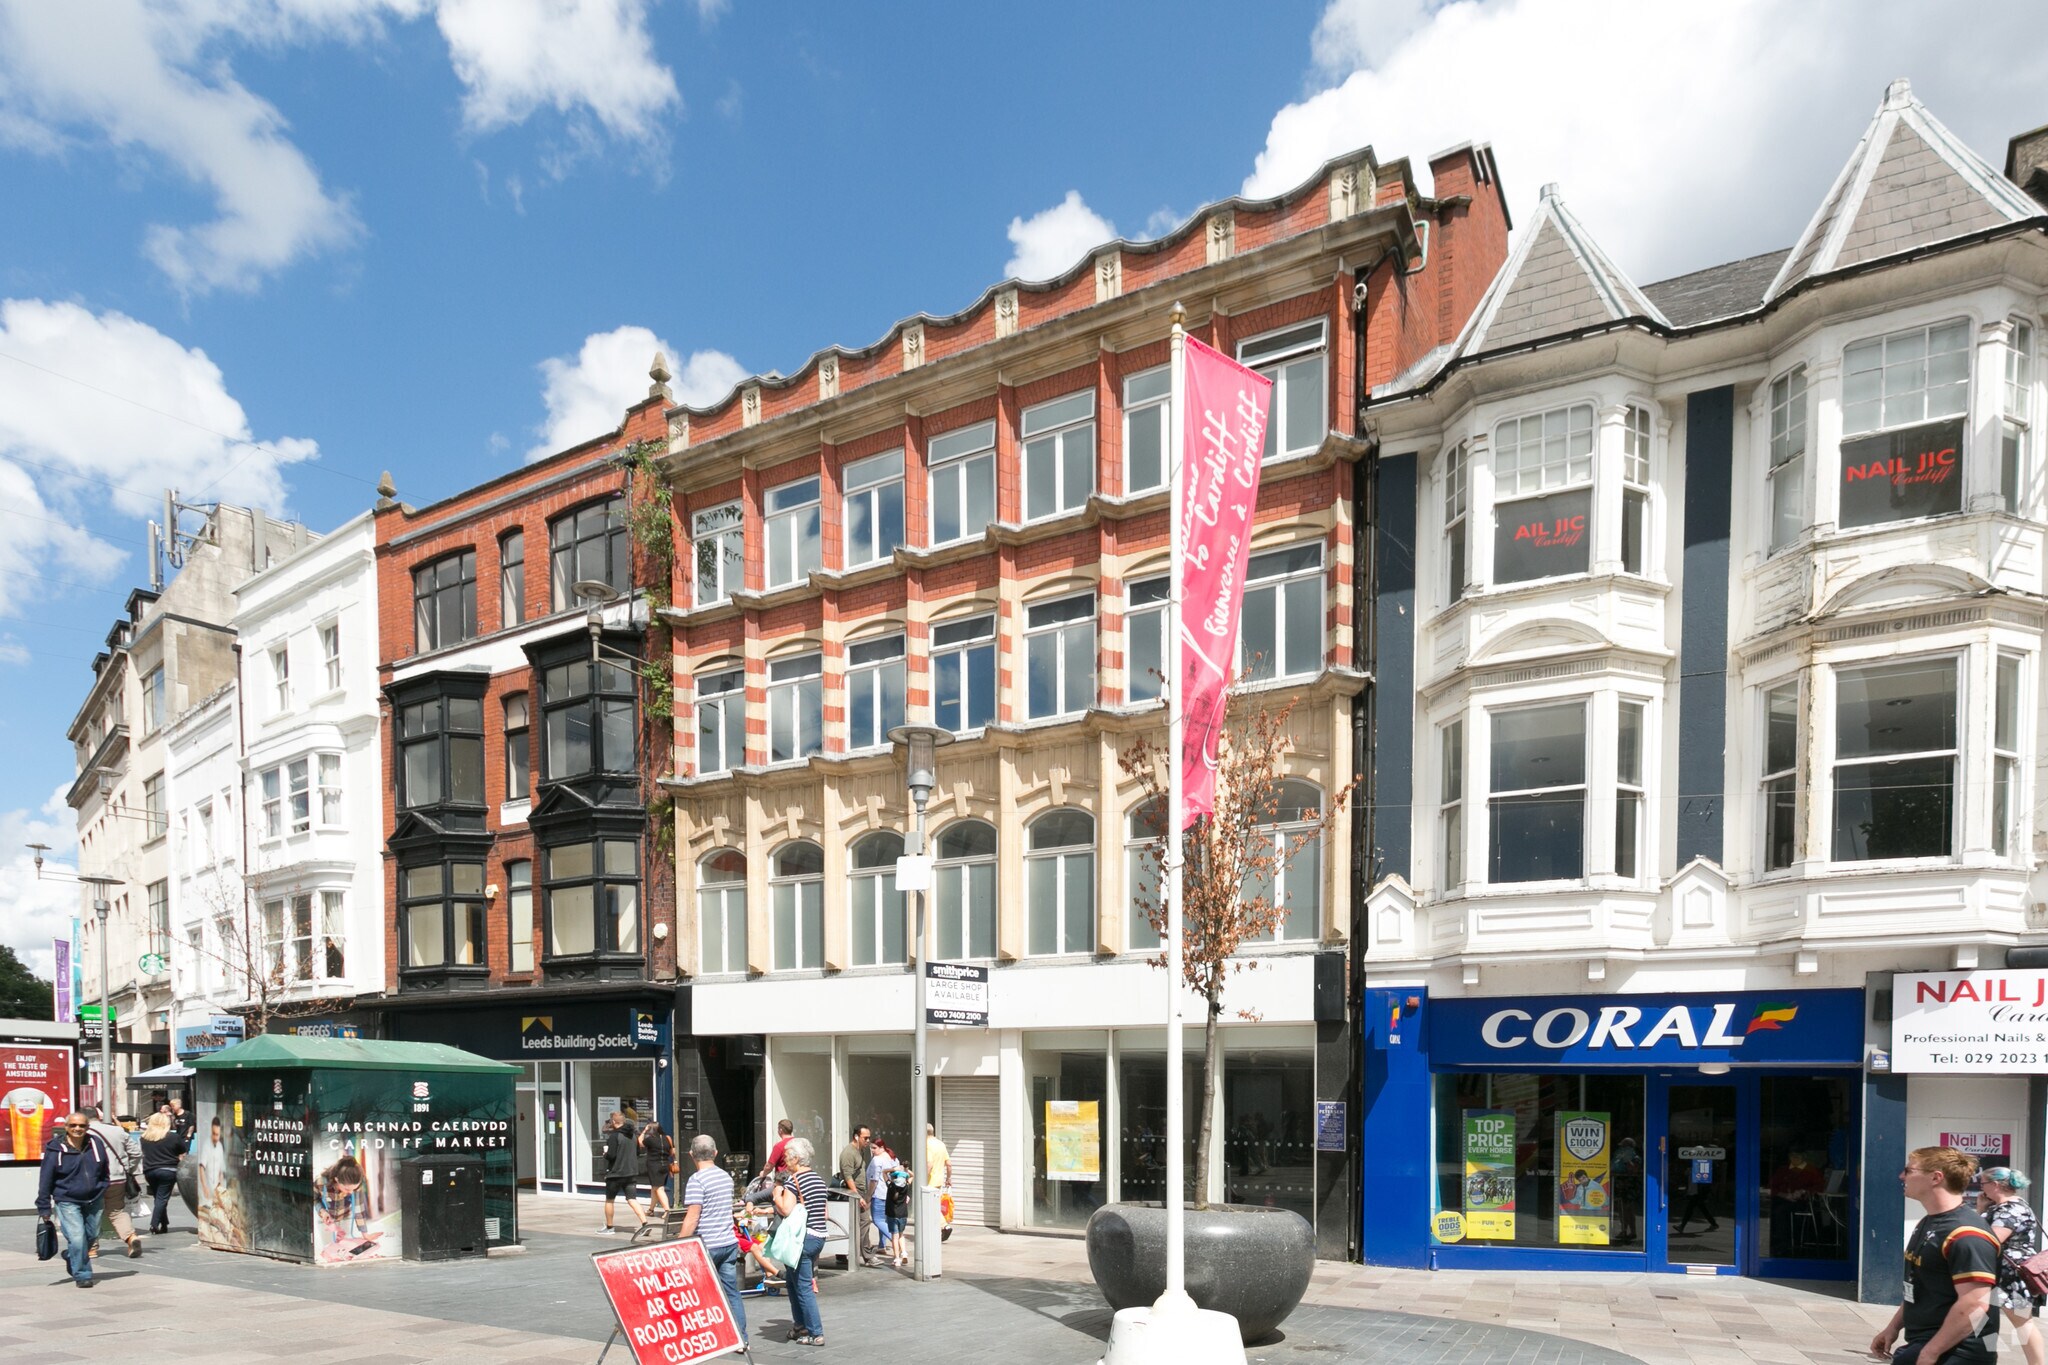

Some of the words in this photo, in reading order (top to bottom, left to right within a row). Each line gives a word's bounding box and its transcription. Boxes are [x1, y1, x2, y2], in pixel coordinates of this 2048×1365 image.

[1234, 389, 1267, 489] Cardiff
[1194, 409, 1238, 526] Cardiff
[1846, 457, 1911, 482] NAIL
[1916, 448, 1956, 474] JIC
[1514, 522, 1550, 542] AIL
[1554, 515, 1585, 538] JIC
[1186, 544, 1209, 571] to
[932, 965, 980, 979] smithprice
[931, 980, 958, 990] LARGE
[961, 982, 982, 992] SHOP
[1917, 979, 2021, 1003] NAIL
[934, 990, 980, 1001] AVAILABLE
[933, 1010, 949, 1019] 020
[949, 1011, 966, 1020] 7409
[966, 1012, 982, 1021] 2100
[297, 1025, 331, 1038] GREGGS
[638, 1027, 658, 1036] Building
[1481, 1003, 1746, 1049] CORAL
[522, 1036, 553, 1049] Leeds
[554, 1035, 596, 1050] Building
[638, 1033, 657, 1042] Society
[1904, 1033, 1989, 1043] Professional
[1994, 1033, 2031, 1043] Nails
[2035, 1033, 2046, 1042] &
[1930, 1053, 1958, 1064] Tel:
[1965, 1053, 1993, 1064] 029
[2000, 1053, 2037, 1064] 2023
[915, 1065, 921, 1076] 5
[413, 1104, 429, 1112] 1891
[255, 1119, 304, 1131] MARCHNAD
[327, 1122, 422, 1133] MARCHNAD
[432, 1121, 508, 1131] CAERDYDD
[1475, 1120, 1505, 1133] TOP
[257, 1132, 302, 1144] CAERDYDD
[1570, 1128, 1600, 1137] WIN
[329, 1138, 423, 1150] CARDIFF
[436, 1137, 507, 1147] MARKET
[1468, 1133, 1513, 1147] PRICE
[1570, 1138, 1599, 1148] £100K
[1950, 1134, 1976, 1147] Nail
[1981, 1135, 2001, 1147] Jic
[255, 1150, 304, 1164] CARDIFF
[259, 1164, 301, 1177] MARKET
[1438, 1216, 1460, 1224] TREBLE
[1438, 1222, 1461, 1231] ODDS
[625, 1249, 682, 1274] FFORDD
[633, 1268, 693, 1296] YMLAEN
[646, 1298, 667, 1318] AR
[669, 1288, 700, 1312] GAU
[634, 1319, 678, 1347] ROAD
[682, 1306, 725, 1333] AHEAD
[663, 1331, 718, 1363] CLOSED
